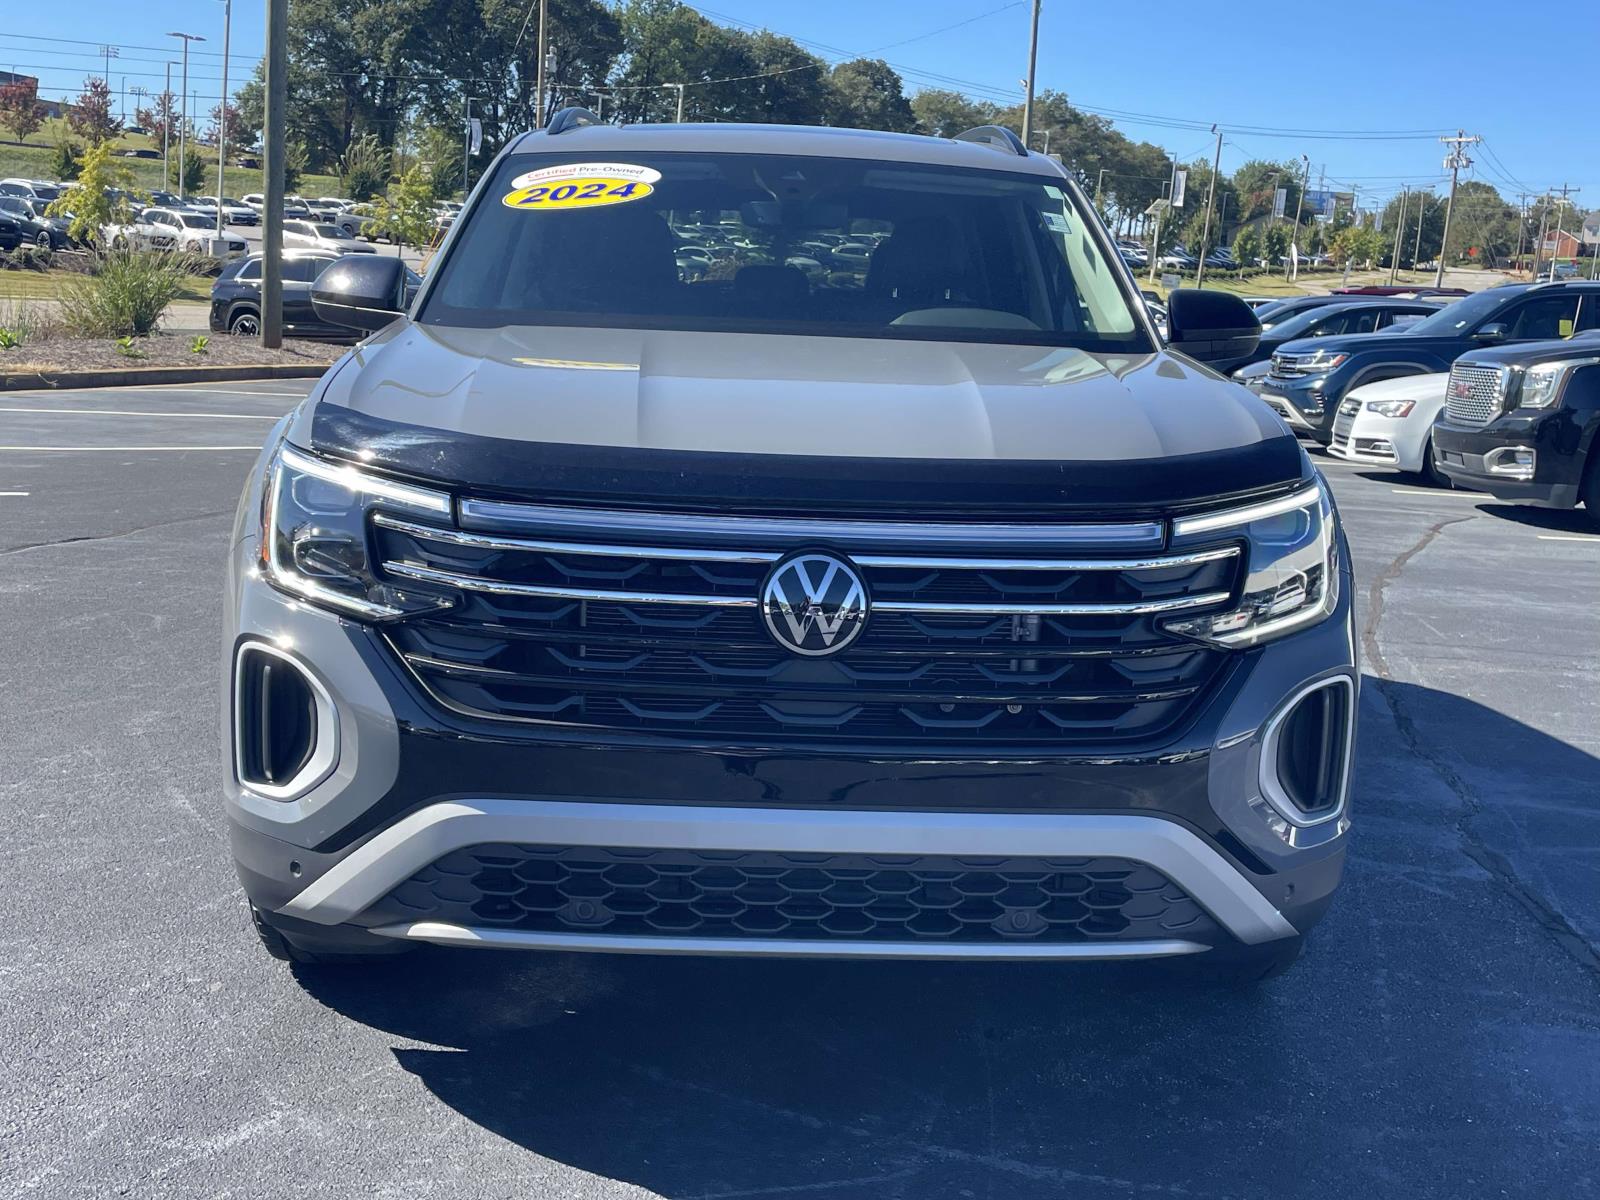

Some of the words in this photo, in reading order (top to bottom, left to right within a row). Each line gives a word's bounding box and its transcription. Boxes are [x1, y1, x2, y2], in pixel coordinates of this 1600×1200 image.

[527, 167, 577, 178] Certified
[579, 166, 645, 175] Pre-Owned
[517, 182, 637, 205] 2024
